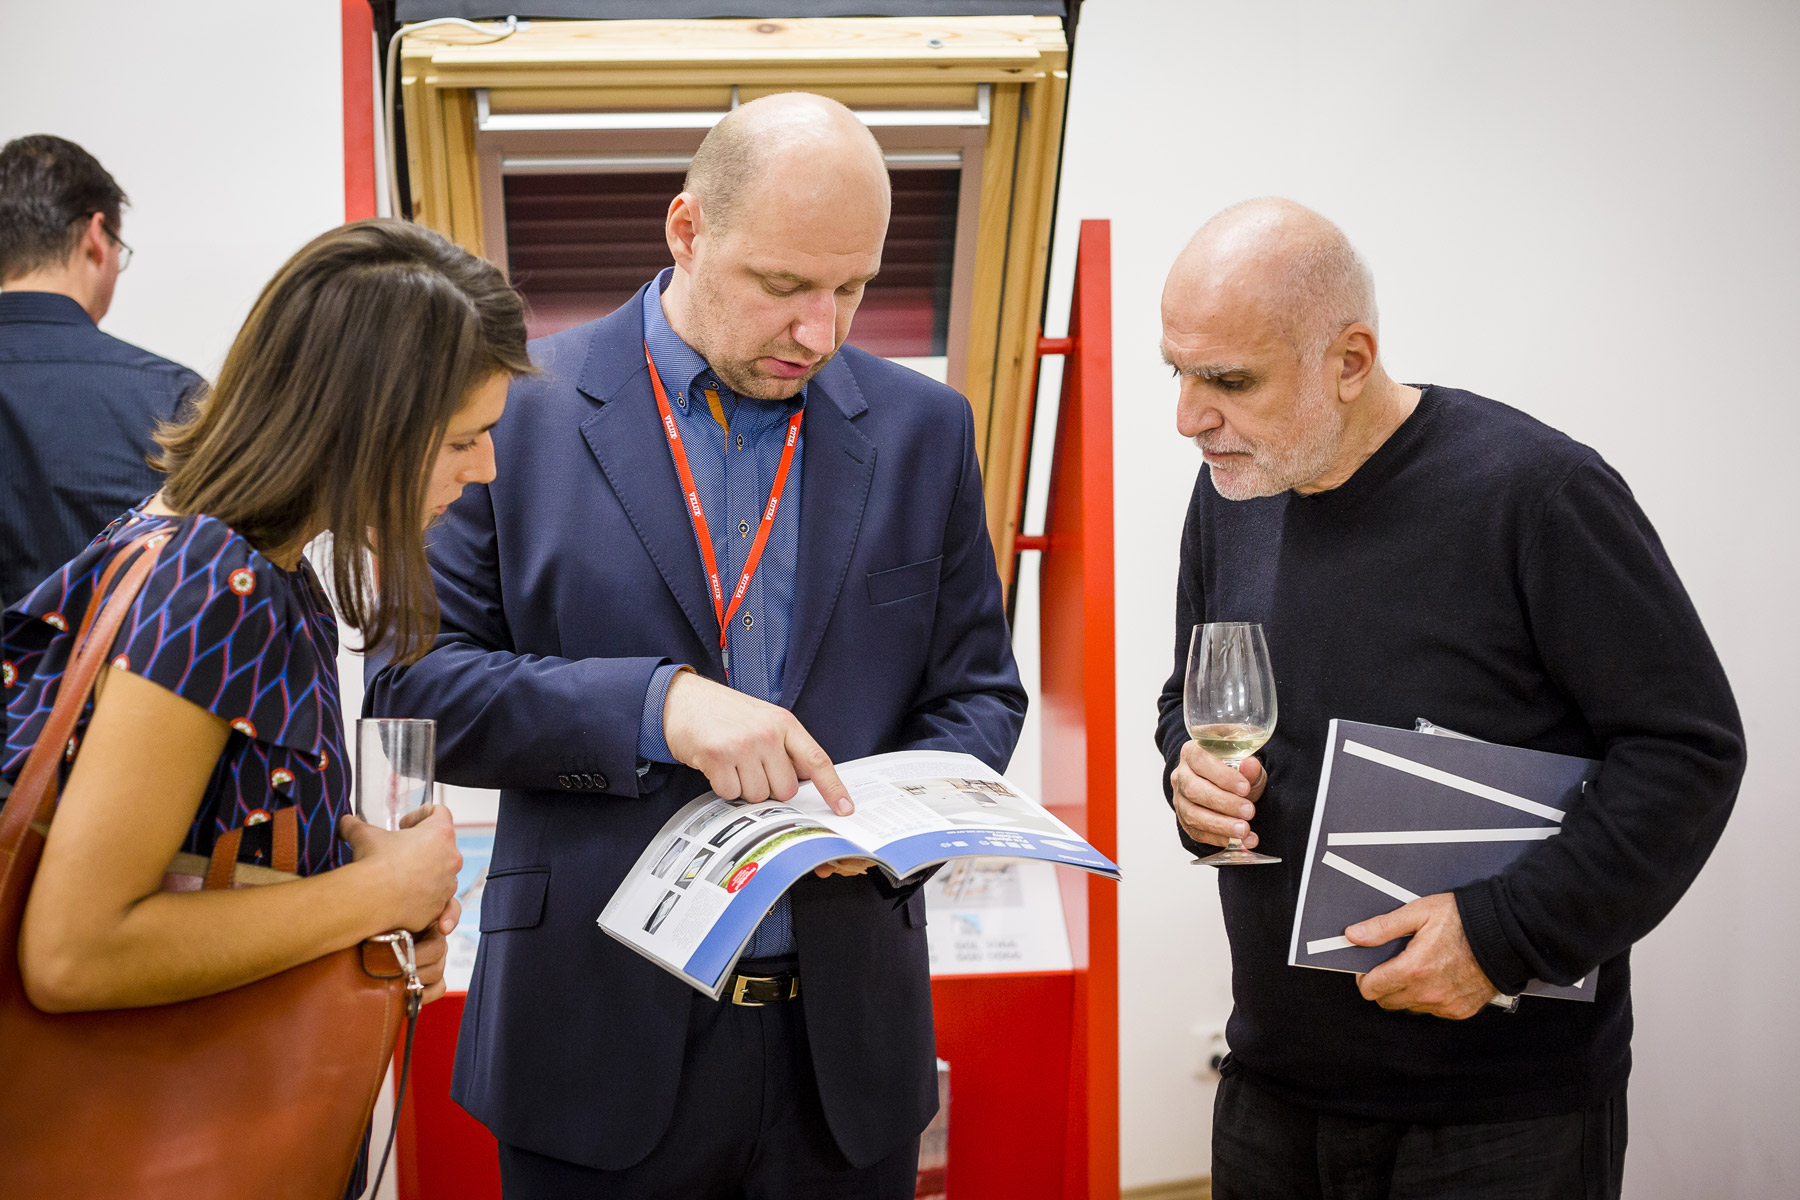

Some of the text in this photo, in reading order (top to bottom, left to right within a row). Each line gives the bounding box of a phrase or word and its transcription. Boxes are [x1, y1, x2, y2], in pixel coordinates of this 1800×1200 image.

[665, 414, 678, 439] VELUX
[787, 424, 798, 447] VELUX
[689, 491, 702, 517] VELUX
[765, 496, 778, 521] VELUX
[711, 573, 721, 601] VELUX
[735, 573, 750, 599] VELUX
